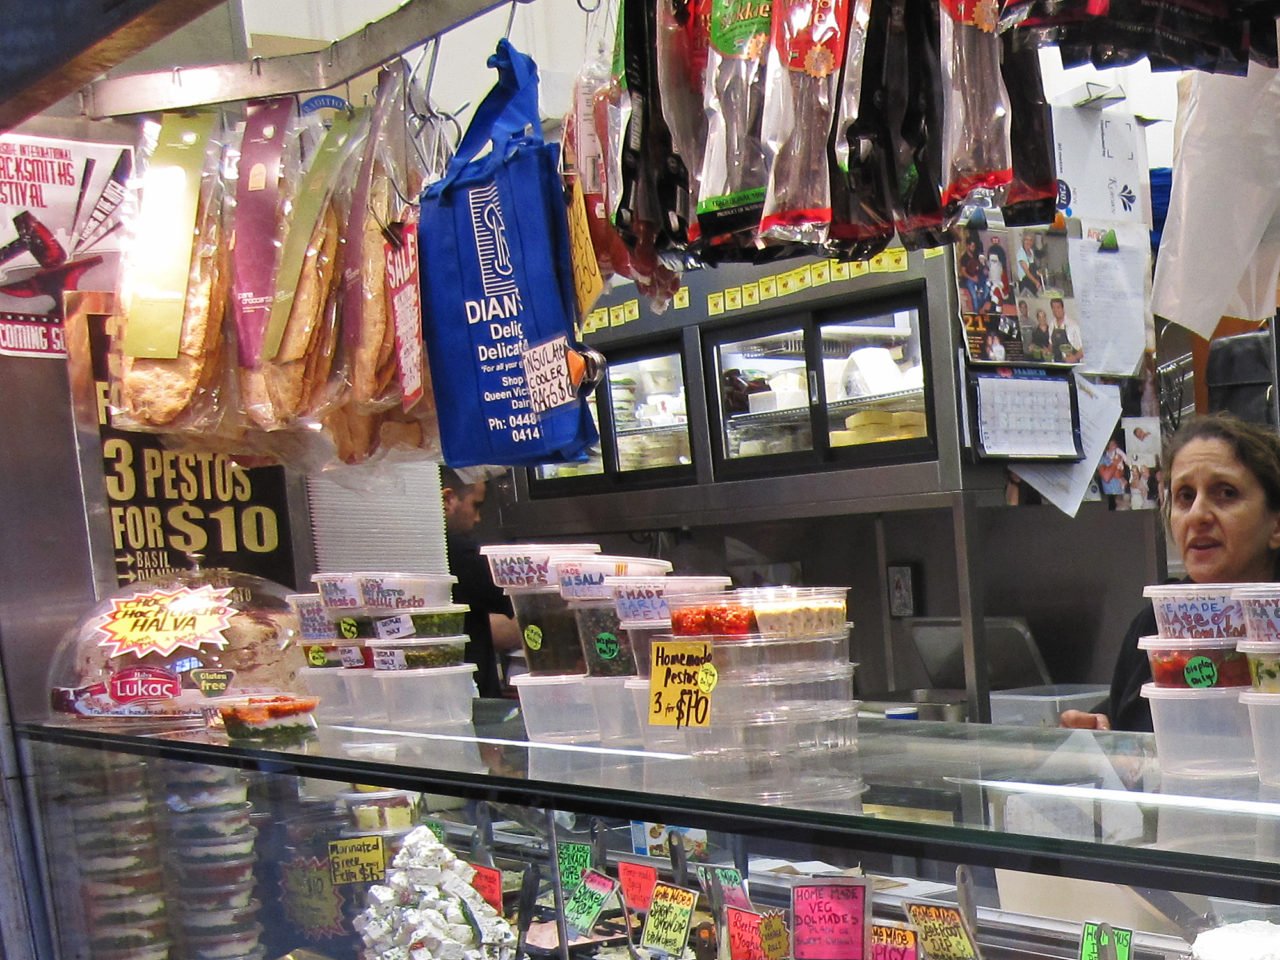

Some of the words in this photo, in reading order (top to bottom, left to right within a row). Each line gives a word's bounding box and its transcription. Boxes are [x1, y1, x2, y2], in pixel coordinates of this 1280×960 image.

[385, 233, 418, 290] SALE
[0, 324, 48, 350] COMING
[528, 364, 565, 390] COOLER
[1013, 367, 1047, 376] MARCH
[501, 375, 524, 387] Shop
[484, 389, 512, 402] Queen
[488, 418, 507, 431] Ph:
[509, 412, 538, 428] 0448
[511, 428, 540, 443] 0414
[103, 438, 137, 501] 3
[143, 447, 252, 502] PESTOS
[111, 506, 165, 550] FOR
[167, 501, 279, 553] $10
[136, 550, 171, 568] BASIL
[1178, 601, 1221, 613] MADE
[130, 615, 198, 632] HALVA
[200, 672, 228, 681] Gluten
[663, 666, 699, 688] Pestos
[201, 681, 226, 691] free
[653, 690, 663, 714] 3
[330, 837, 380, 855] Marinated
[796, 888, 824, 901] HOME
[808, 900, 833, 914] VEG
